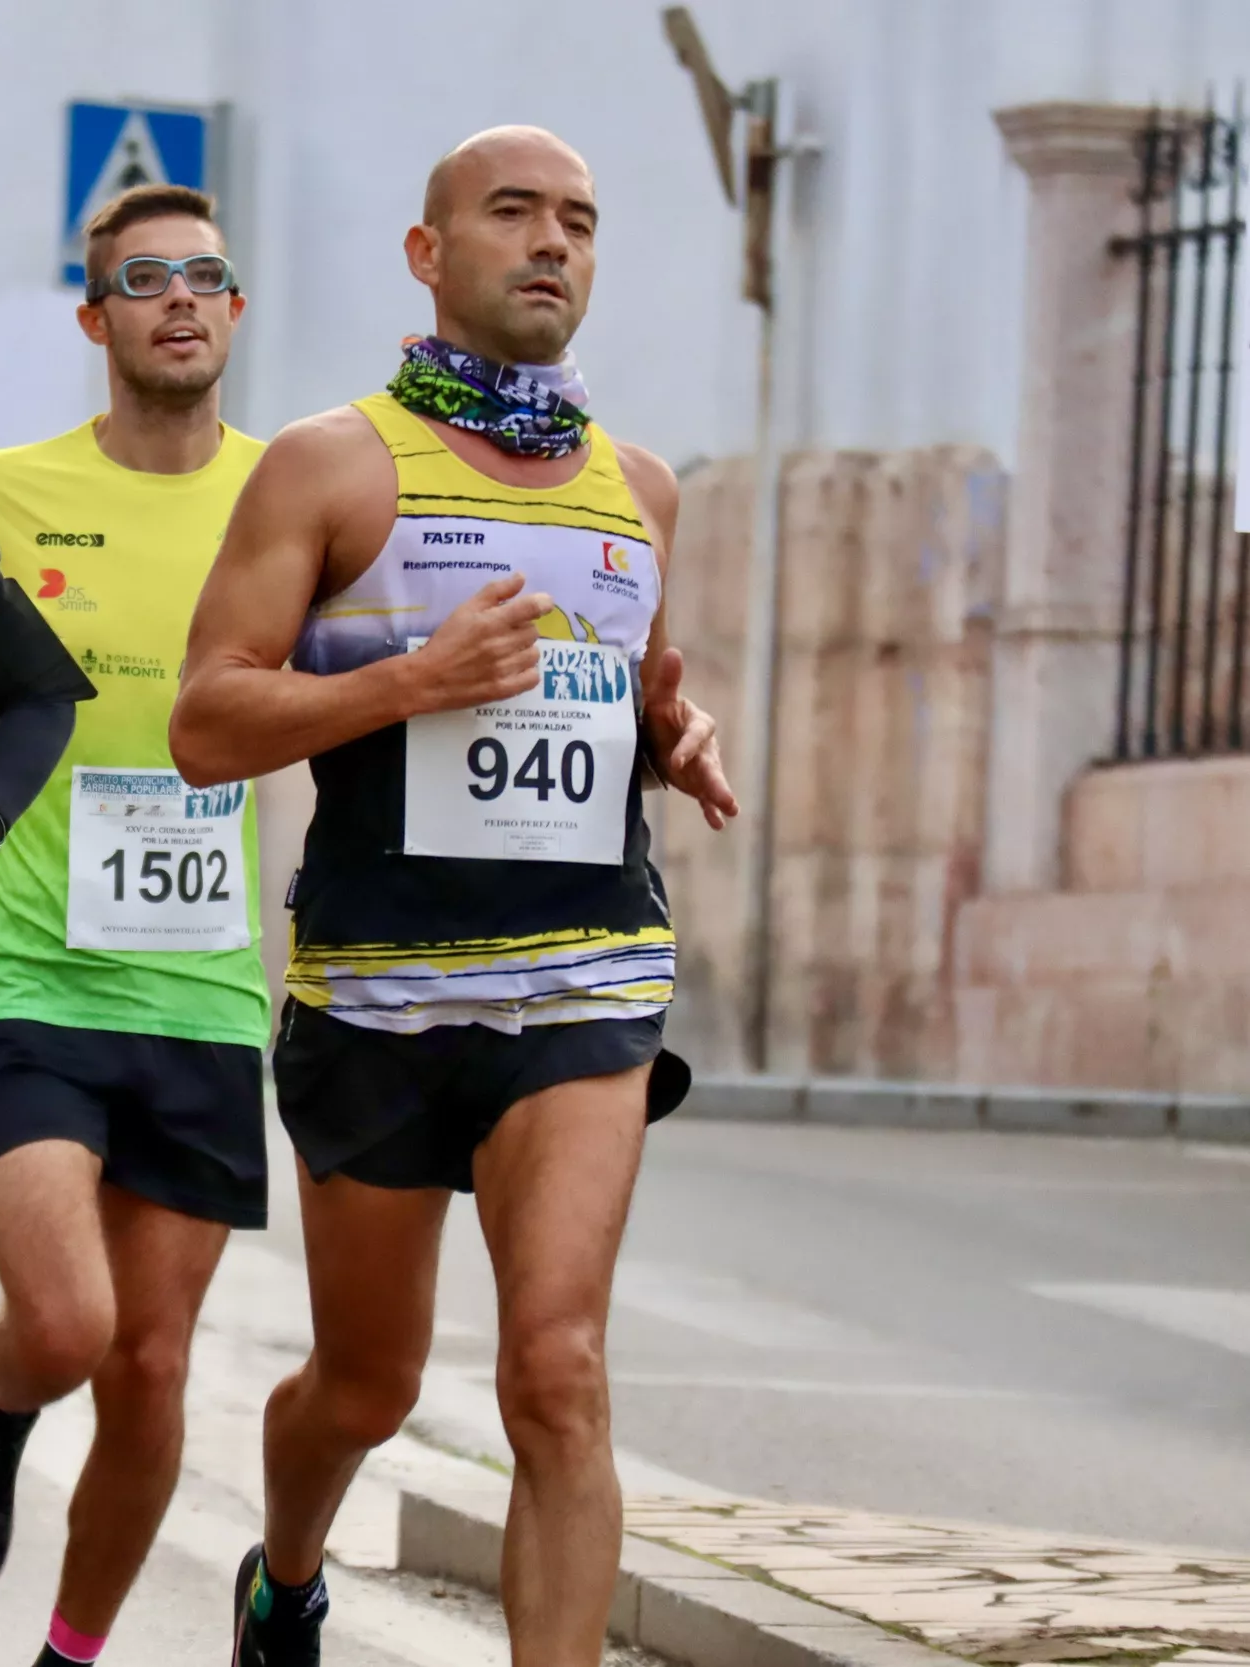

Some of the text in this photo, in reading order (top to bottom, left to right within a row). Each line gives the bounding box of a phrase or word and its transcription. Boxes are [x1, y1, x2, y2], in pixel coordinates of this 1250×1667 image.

[36, 533, 89, 547] emec
[423, 532, 485, 545] FASTER
[403, 560, 511, 572] #teamperezcampos
[592, 569, 639, 589] Diputación
[592, 582, 604, 591] de
[67, 587, 84, 600] DS
[58, 599, 97, 612] Smith
[106, 654, 161, 666] BODEGAS
[543, 648, 593, 673] 2024
[99, 663, 166, 679] EL MONTE
[476, 708, 495, 716] XXV
[515, 709, 546, 717] CIUDAD
[548, 710, 558, 718] DE
[496, 722, 512, 730] POR
[515, 722, 526, 730] LA
[467, 737, 594, 803] 940
[81, 774, 119, 784] CIRCUITO
[121, 775, 169, 785] PROVINCIAL
[81, 783, 182, 794] CARRERAS POPULARES
[102, 849, 229, 904] 1502
